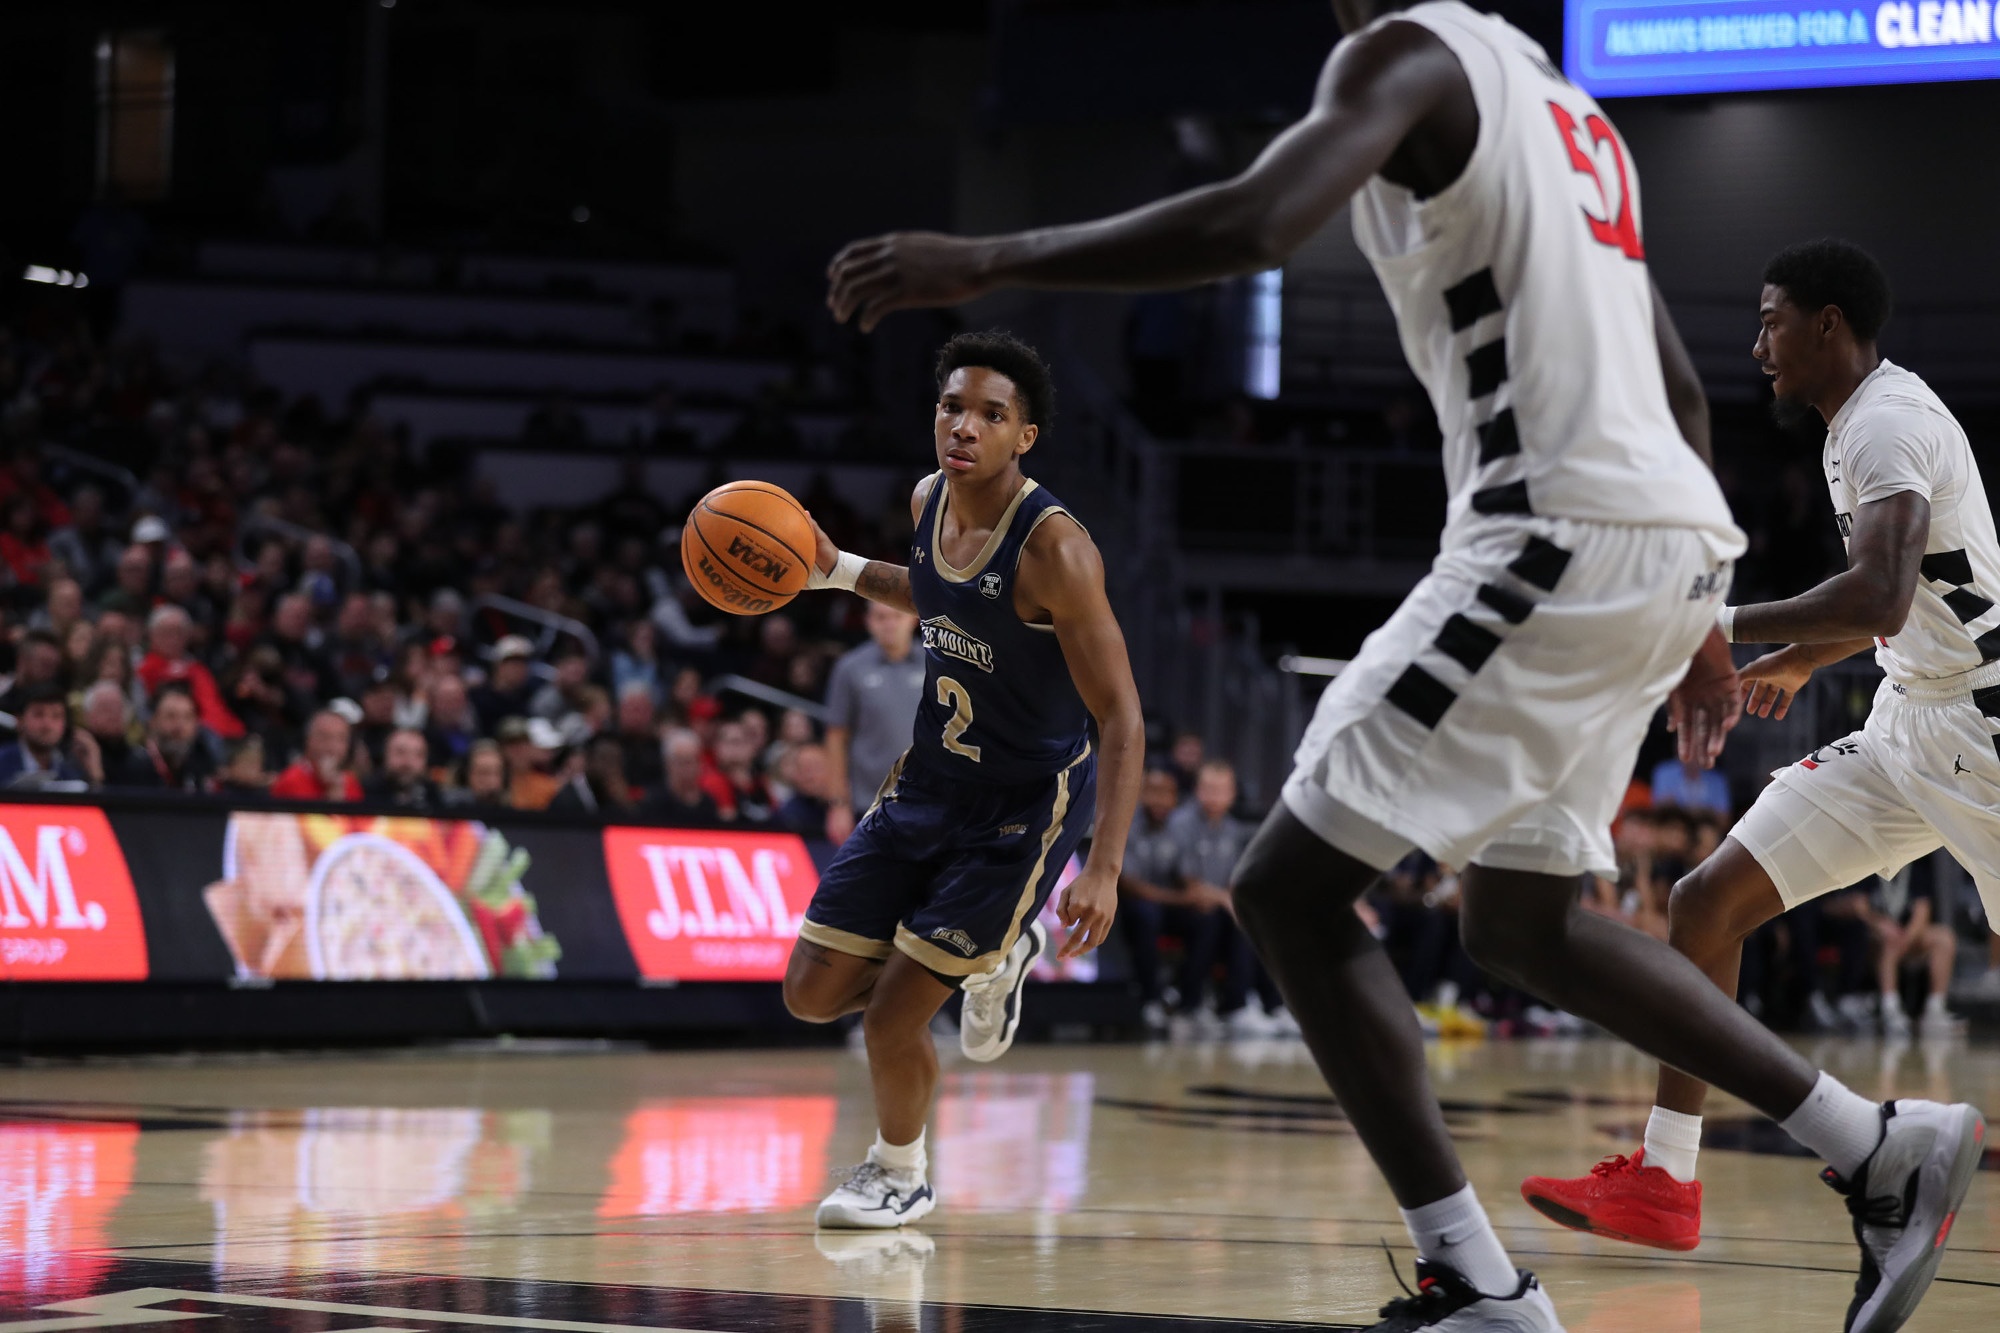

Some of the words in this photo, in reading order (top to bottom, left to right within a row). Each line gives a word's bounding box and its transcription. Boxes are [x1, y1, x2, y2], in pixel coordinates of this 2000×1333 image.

[1605, 18, 1699, 56] ALWAYS
[1700, 12, 1797, 51] BREWED
[1798, 10, 1848, 46] FOR
[1849, 8, 1870, 44] A
[1875, 0, 1991, 48] CLEAN
[698, 555, 773, 611] Wilson
[727, 536, 788, 583] NCAA
[938, 629, 989, 665] MOUNT
[937, 676, 981, 763] 2
[952, 933, 976, 952] MOUNT
